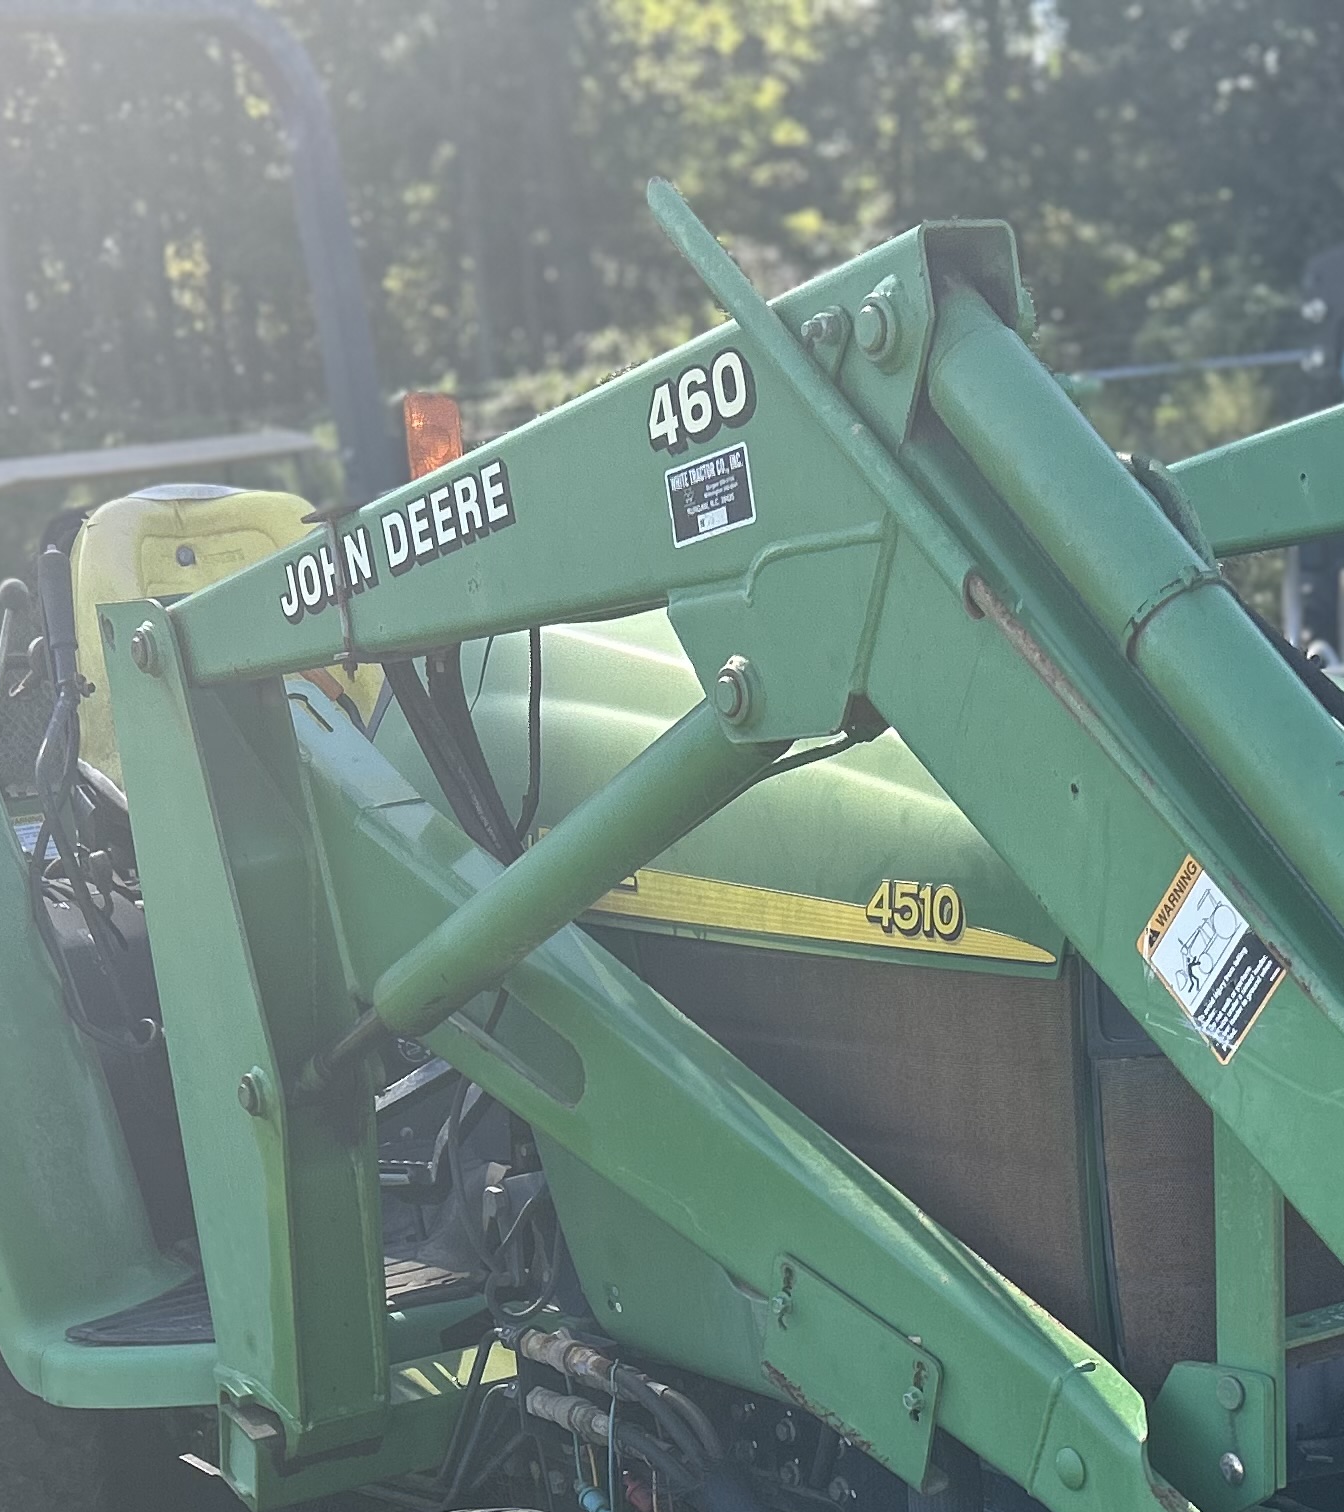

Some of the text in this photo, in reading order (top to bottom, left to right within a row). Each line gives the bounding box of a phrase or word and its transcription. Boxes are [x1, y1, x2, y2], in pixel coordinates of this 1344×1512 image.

[649, 349, 751, 450] 460
[382, 461, 514, 573] DEERE
[866, 879, 962, 938] 4510
[1155, 860, 1198, 926] WARNING
